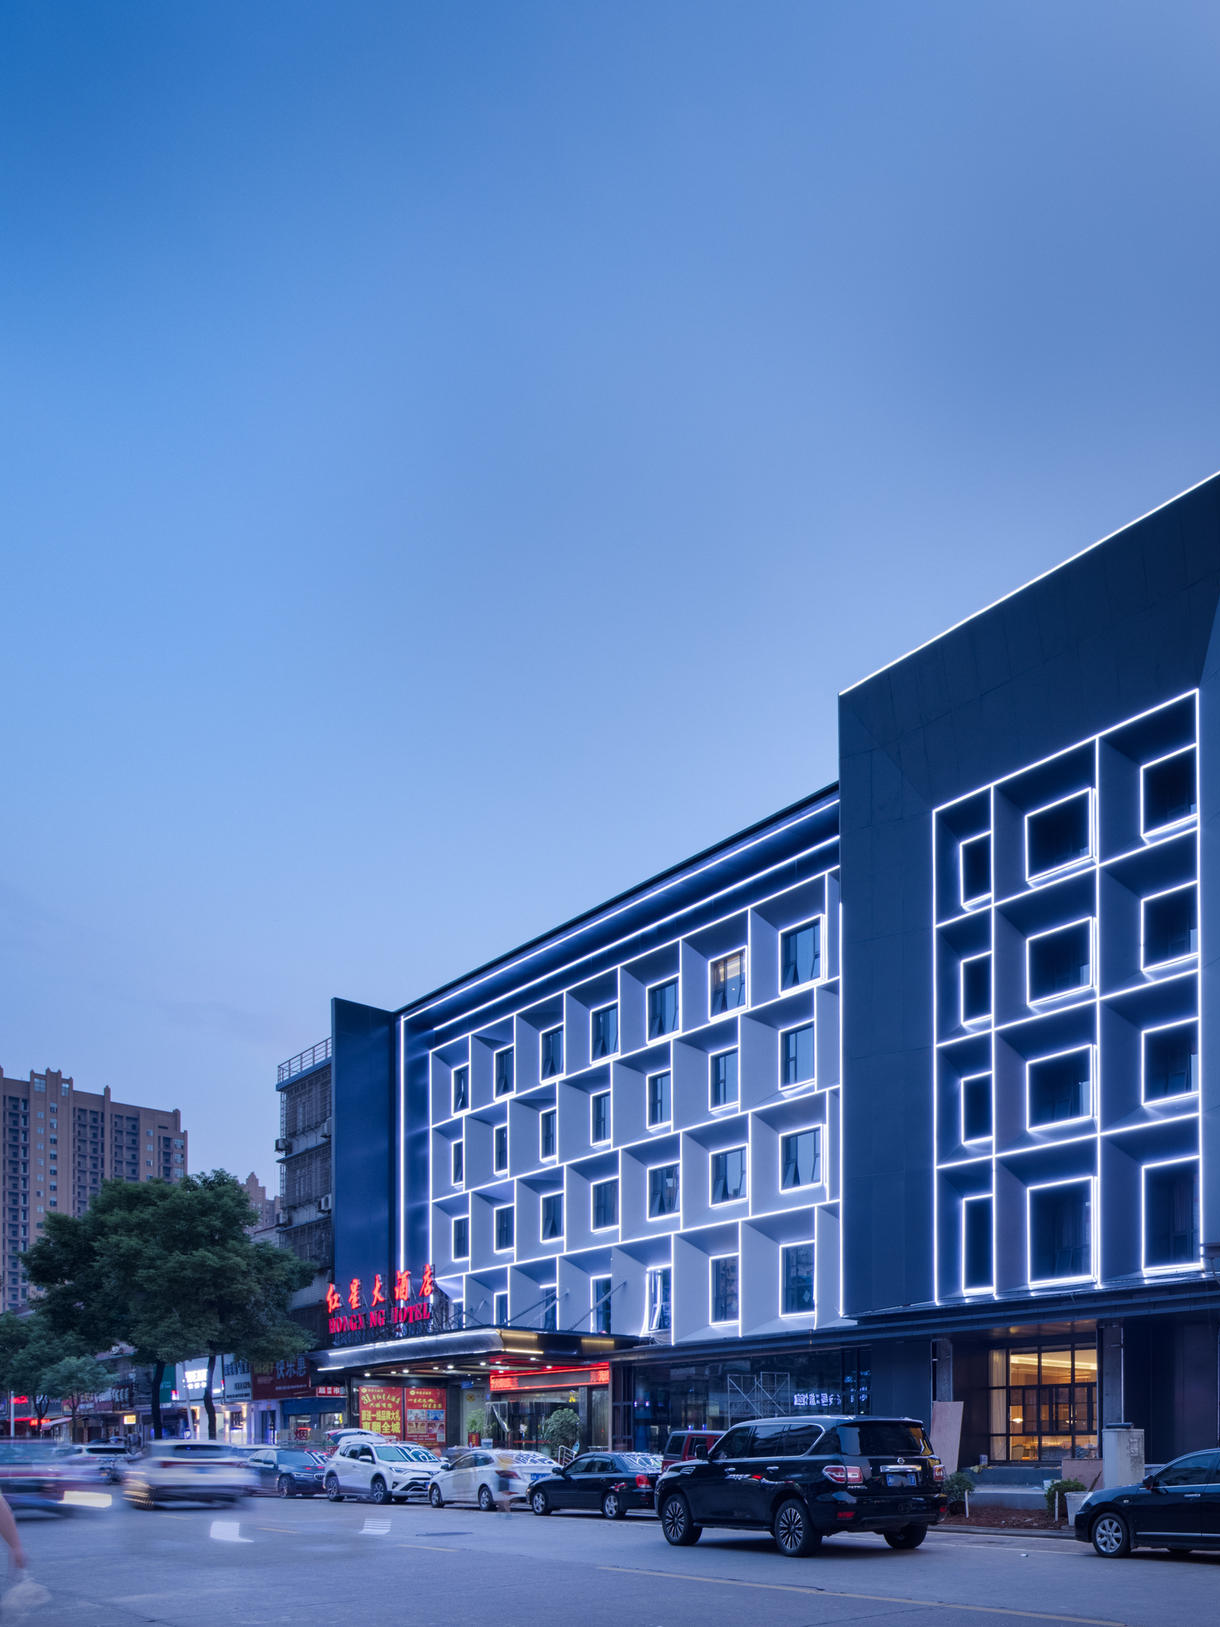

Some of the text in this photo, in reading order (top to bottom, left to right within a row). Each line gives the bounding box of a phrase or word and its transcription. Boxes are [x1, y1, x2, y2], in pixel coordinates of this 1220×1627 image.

[326, 1263, 433, 1314] 红星大酒店
